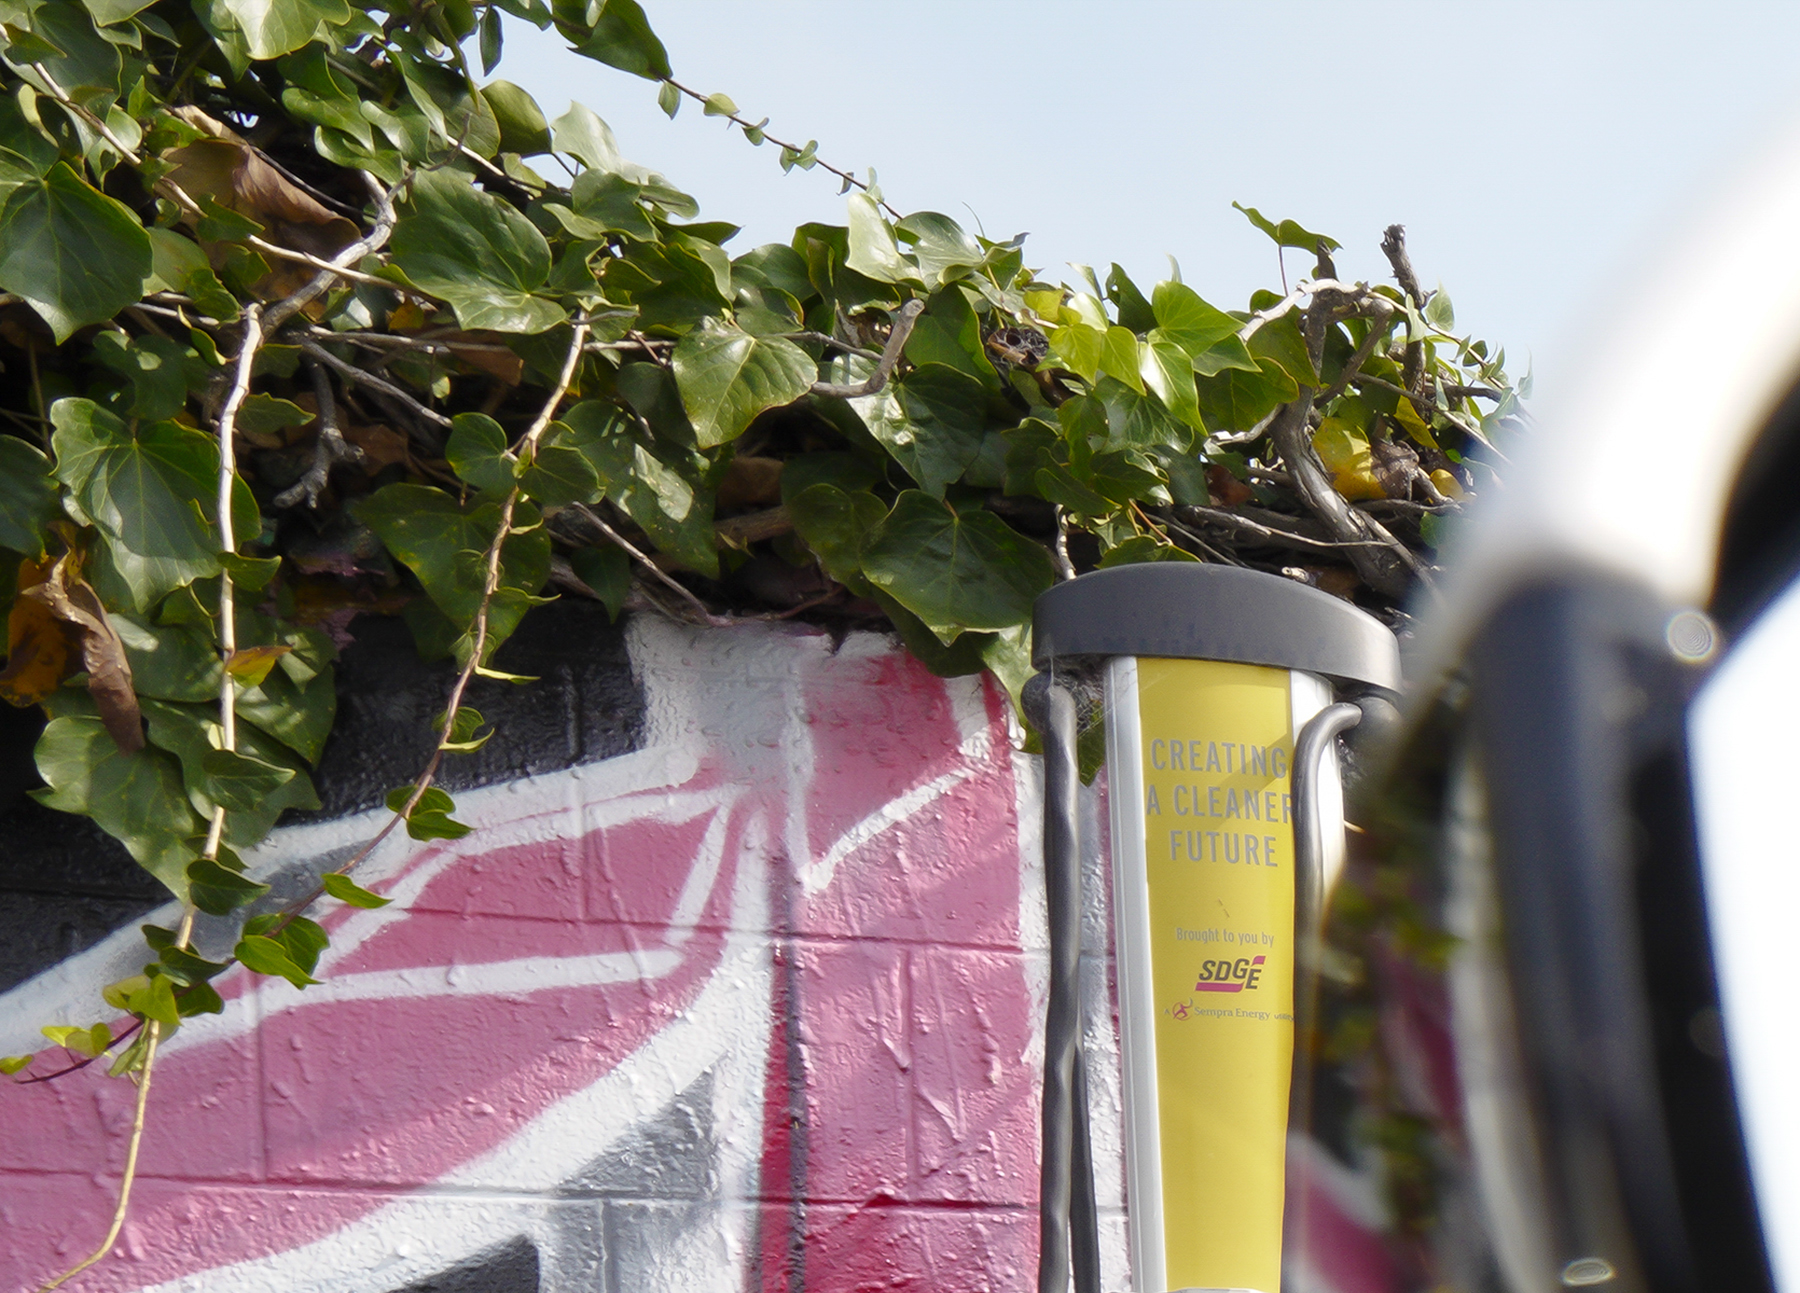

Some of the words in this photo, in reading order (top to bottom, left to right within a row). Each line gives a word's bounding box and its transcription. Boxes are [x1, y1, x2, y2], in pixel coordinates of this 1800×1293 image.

[1151, 738, 1287, 778] CREATING
[1146, 784, 1161, 815] A
[1170, 830, 1278, 867] FUTURE
[1176, 927, 1219, 944] Brought
[1223, 929, 1234, 942] to
[1238, 933, 1258, 946] you
[1262, 932, 1274, 948] by
[1194, 1006, 1233, 1019] Sempra
[1235, 1008, 1271, 1021] Energy
